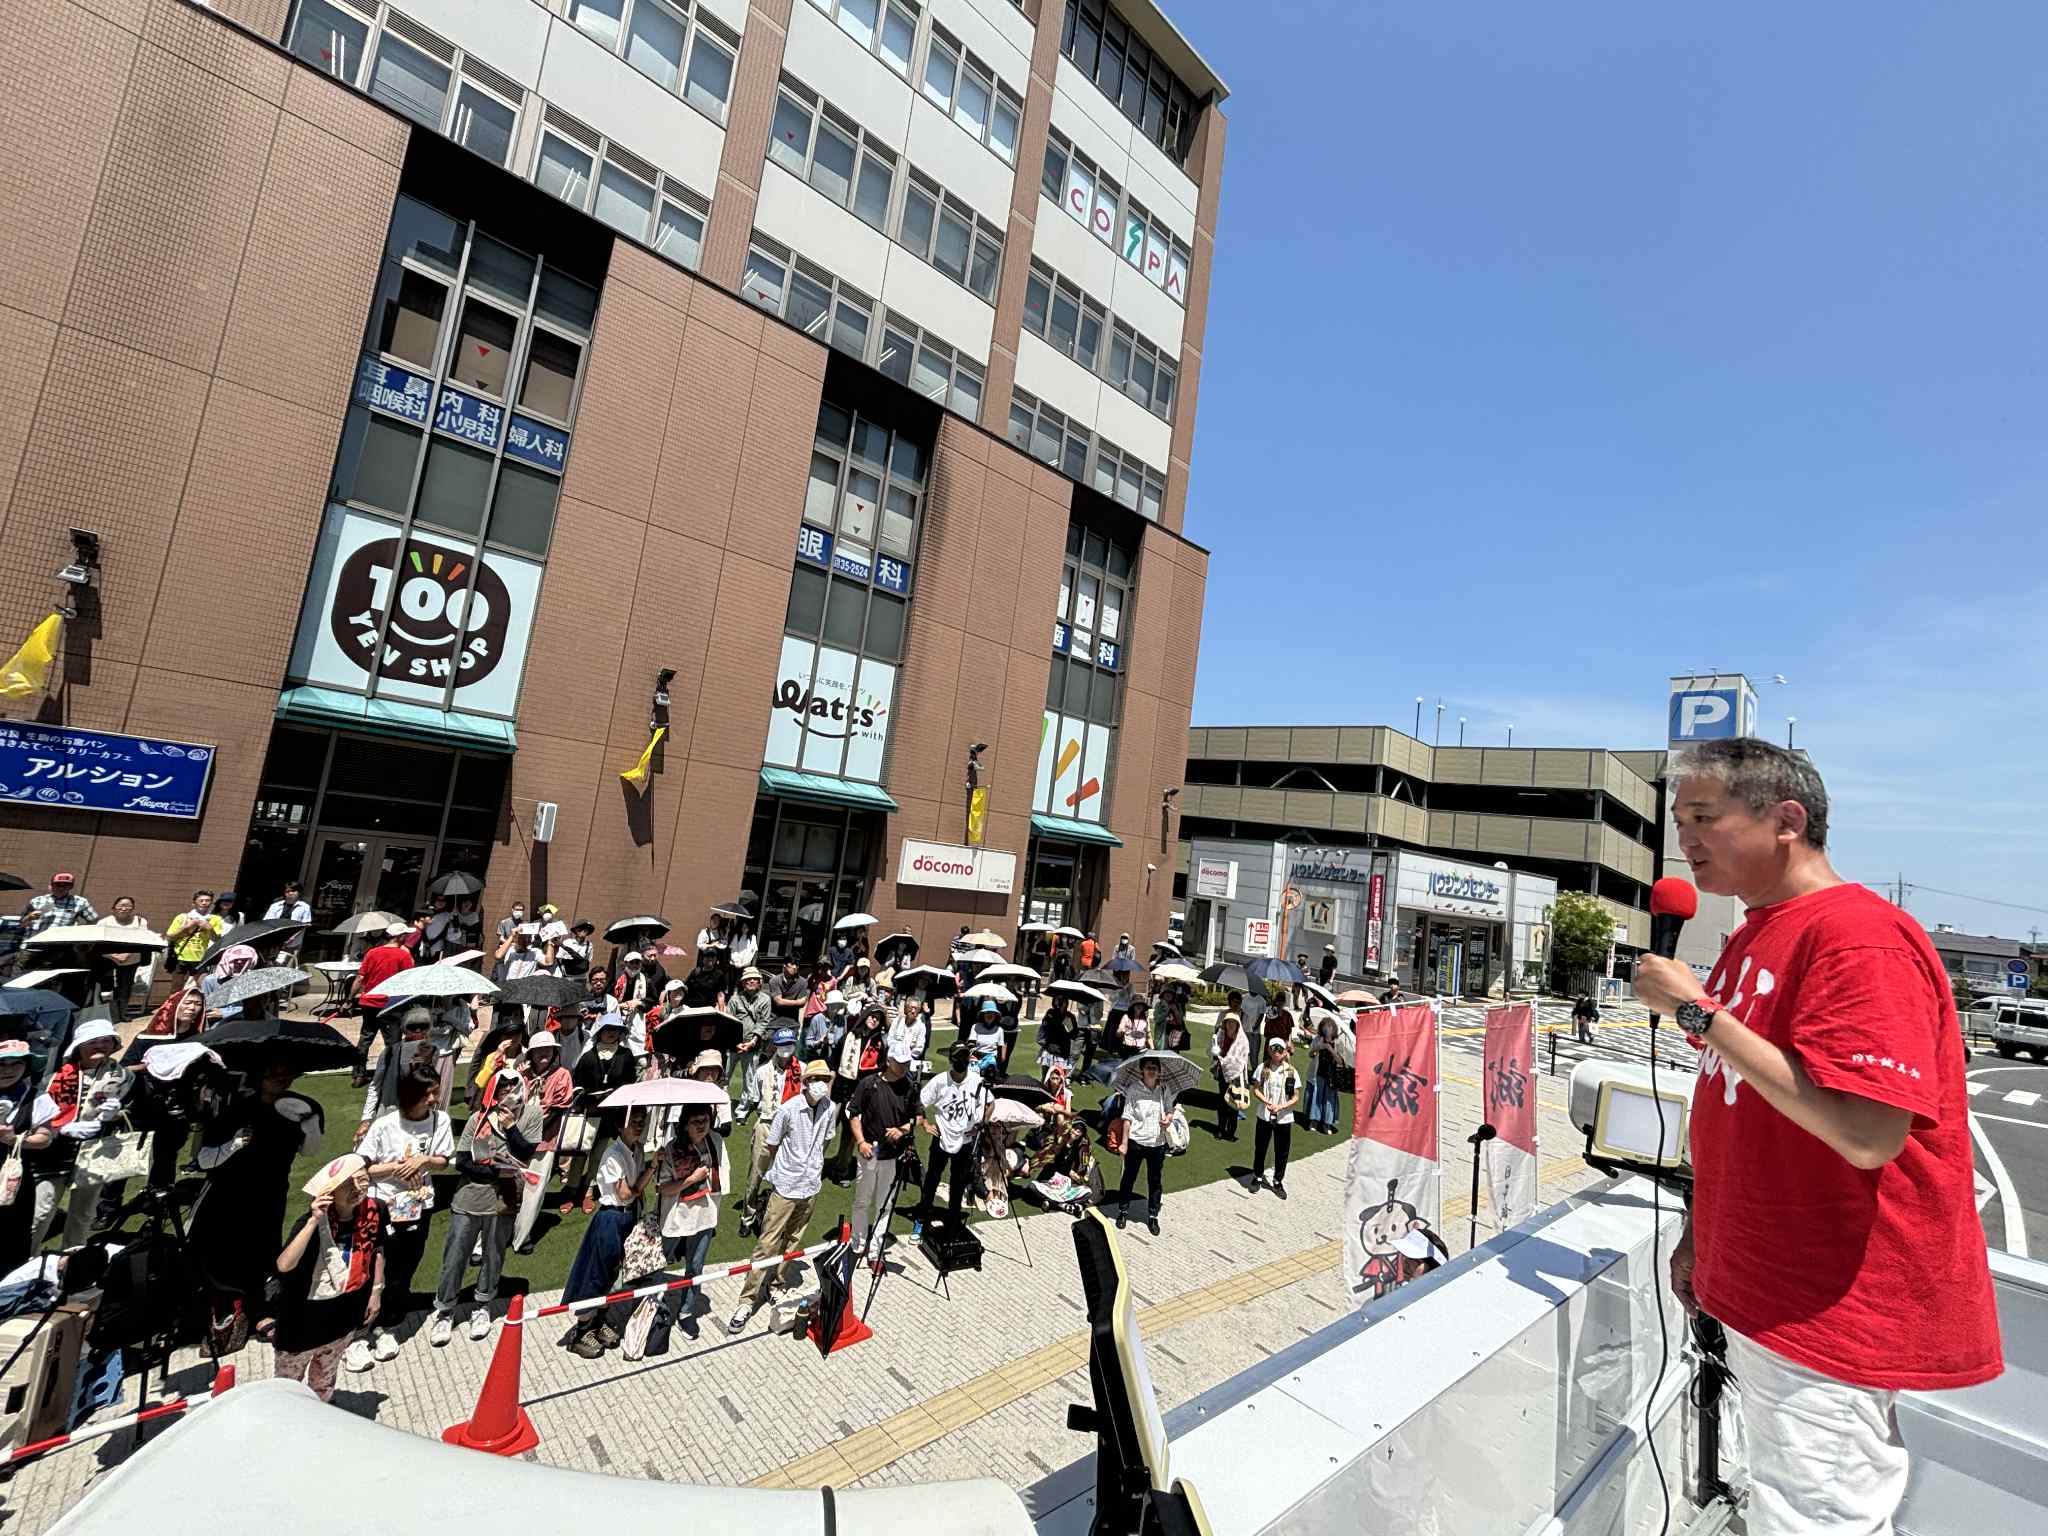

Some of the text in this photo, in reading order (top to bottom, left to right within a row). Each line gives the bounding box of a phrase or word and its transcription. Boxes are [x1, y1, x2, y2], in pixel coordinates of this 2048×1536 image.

[436, 410, 498, 447] 小児科
[508, 425, 565, 462] 婦人科
[879, 558, 902, 589] 科
[369, 565, 490, 632] 100
[408, 637, 489, 678] SHOP
[1098, 641, 1115, 667] 科
[1680, 695, 1730, 736] P
[861, 730, 884, 742] with
[23, 757, 174, 789] アルション
[913, 854, 974, 876] docomo
[2012, 975, 2025, 987] P
